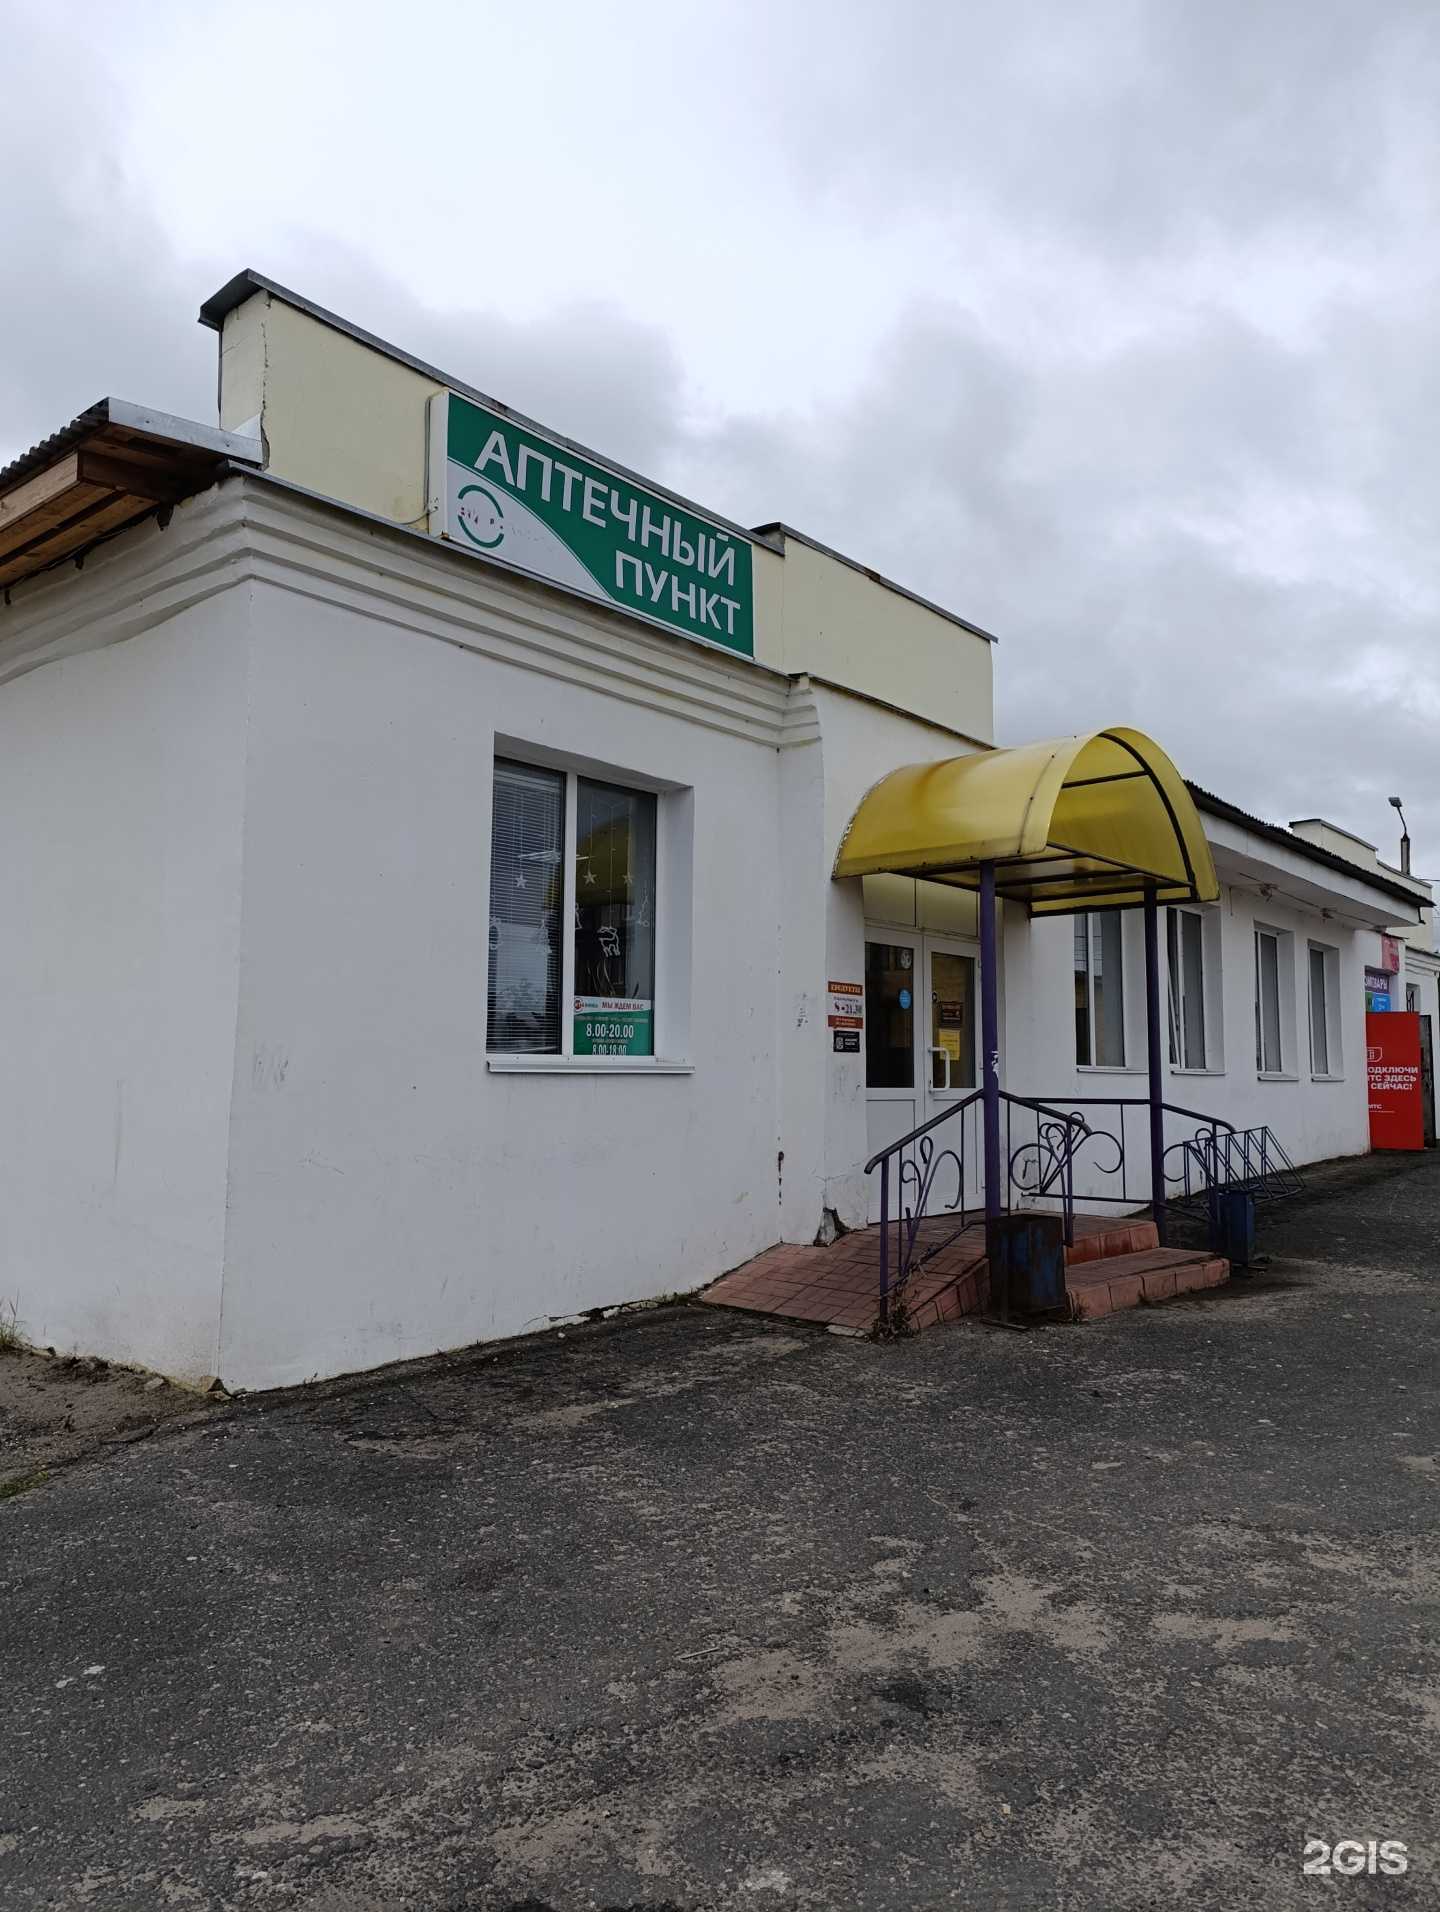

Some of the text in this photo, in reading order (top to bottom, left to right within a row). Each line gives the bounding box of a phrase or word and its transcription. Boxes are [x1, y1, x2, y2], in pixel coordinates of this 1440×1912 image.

[474, 430, 735, 586] АПТЕЧНЫЙ
[615, 550, 741, 635] ПУНКТ
[586, 1023, 634, 1038] 8.00-20.00
[1384, 1074, 1417, 1082] ЗДЕСЬ
[1371, 1082, 1413, 1090] СЕЙЧАС!
